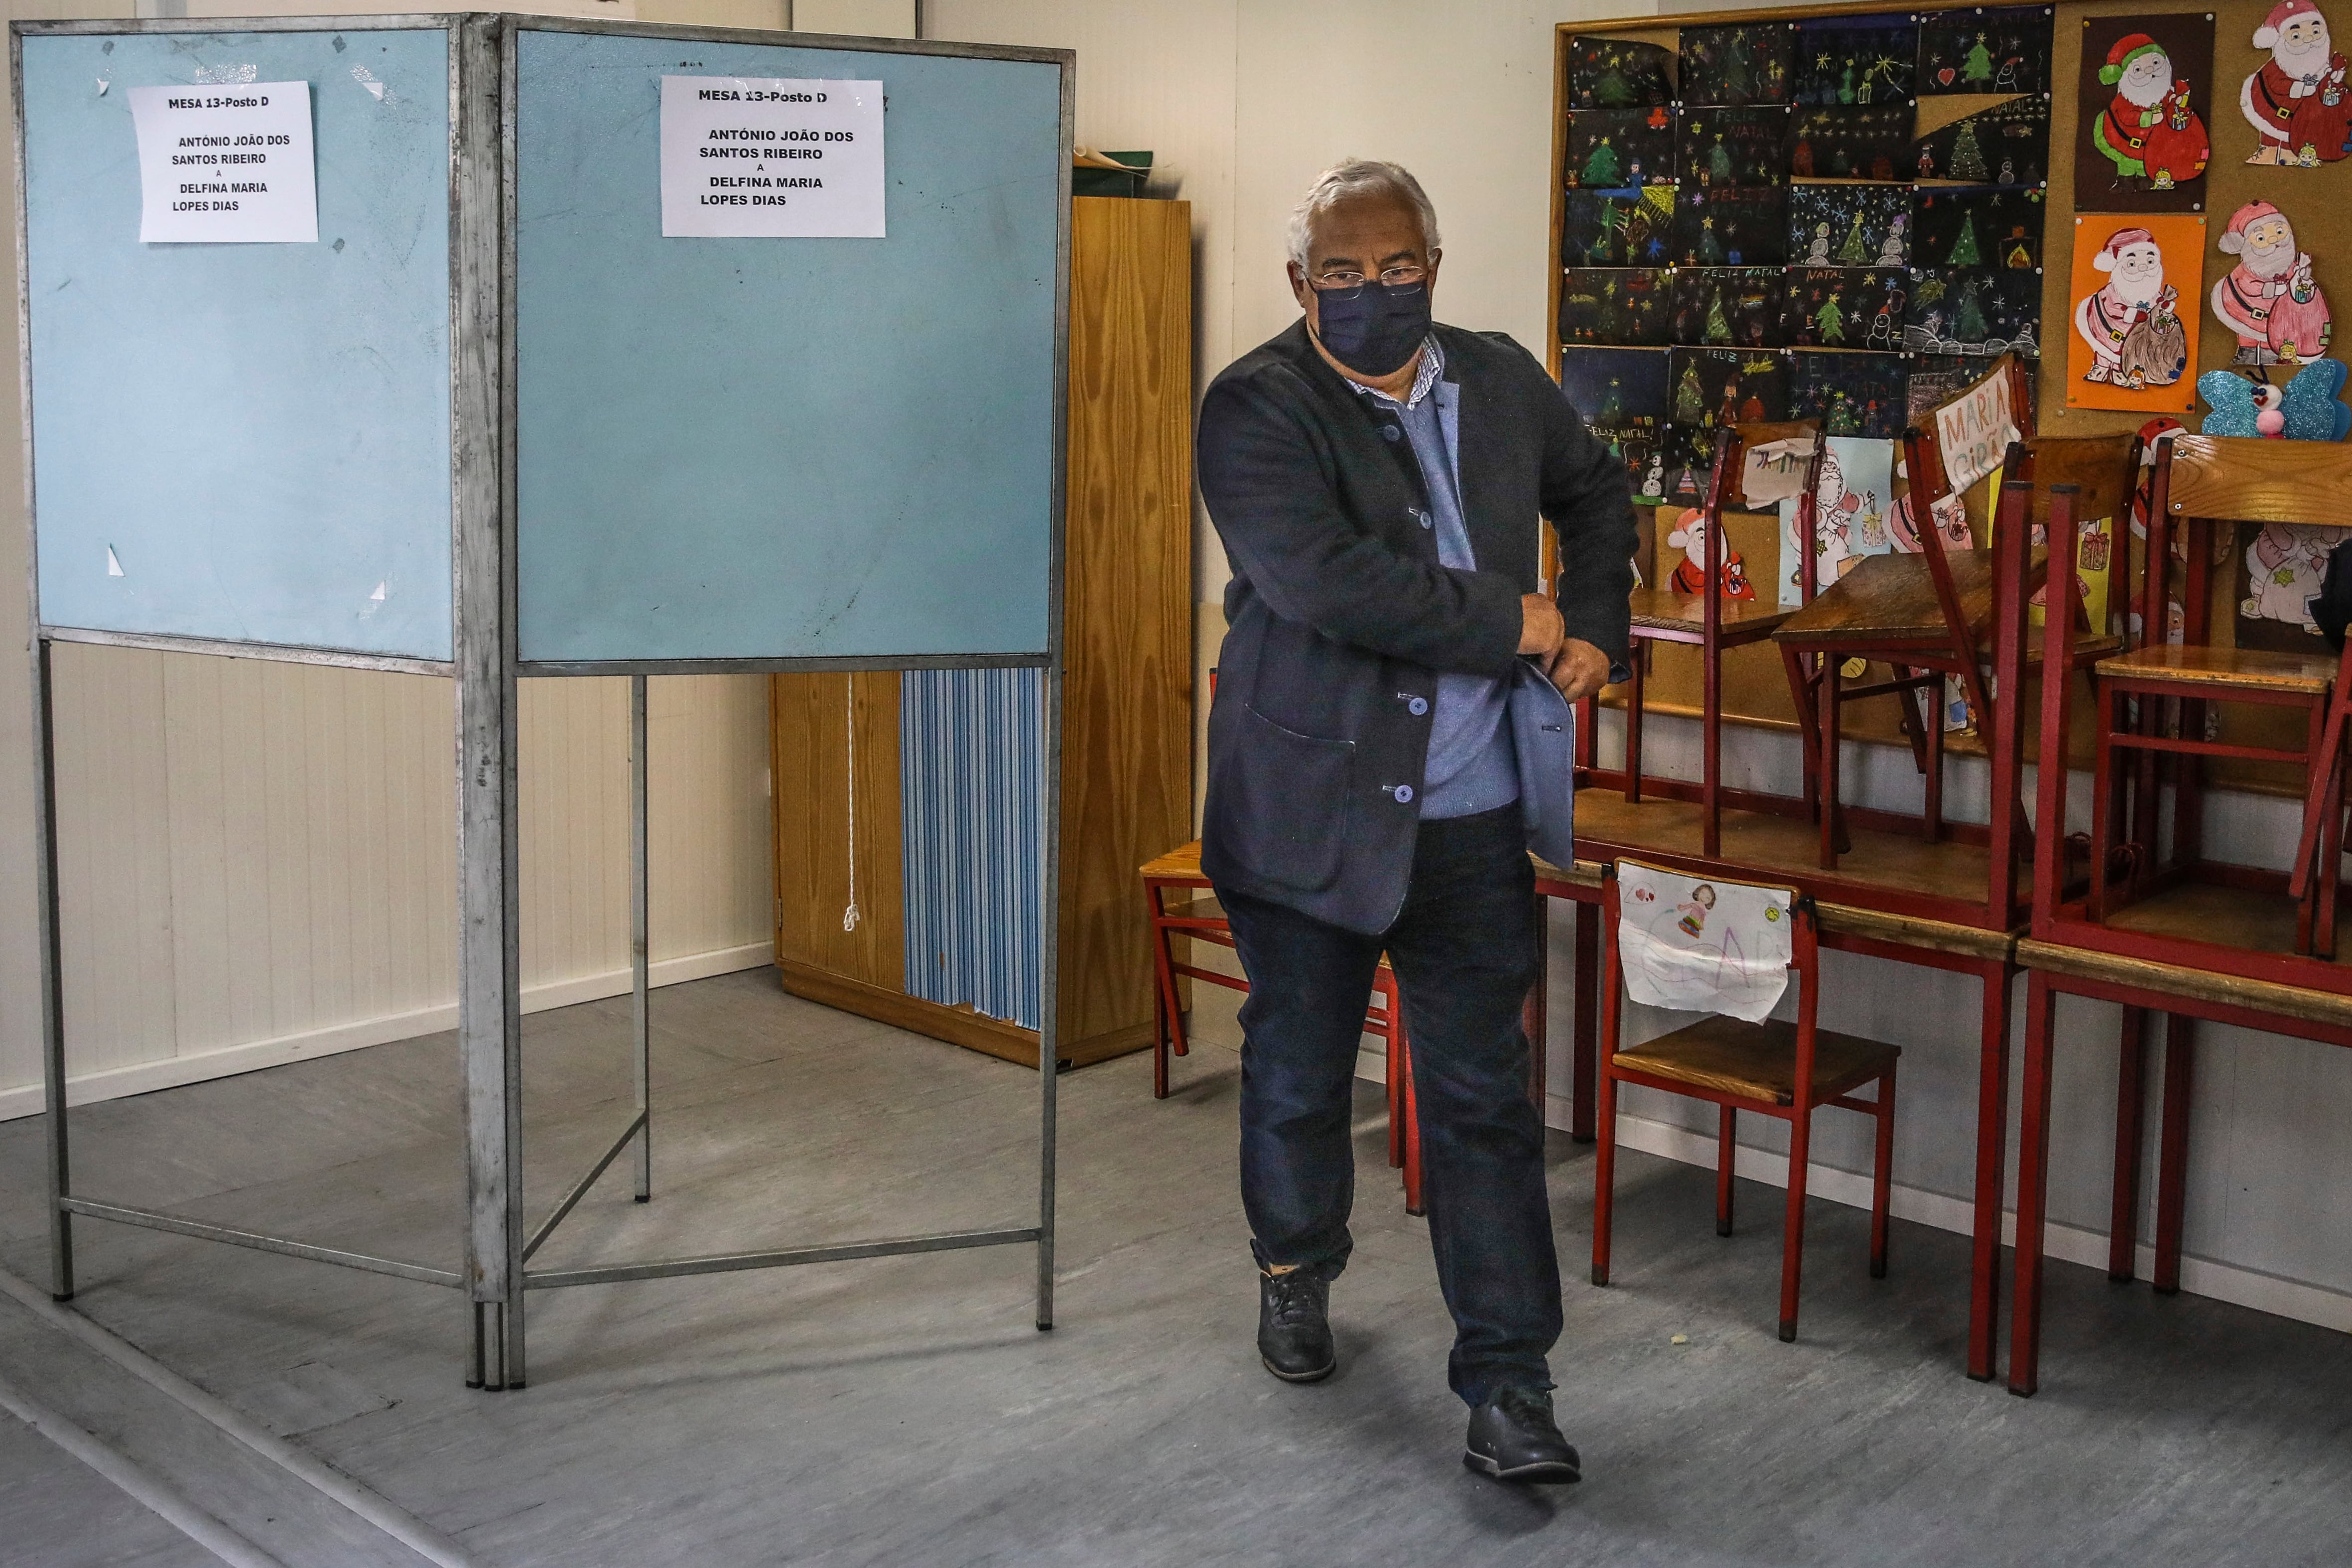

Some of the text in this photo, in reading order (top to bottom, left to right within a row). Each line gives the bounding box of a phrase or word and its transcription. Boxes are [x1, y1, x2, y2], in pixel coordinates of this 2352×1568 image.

[168, 96, 269, 110] MESA 13-Posto D
[698, 89, 828, 104] MESA 13-Posto D
[178, 133, 290, 148] ANTÓNIO JOÃO DOS
[708, 127, 854, 142] ANTÓNIO JOÃO DOS
[171, 153, 266, 166] SANTOS RIBEIRO
[699, 146, 823, 160] SANTOS RIBEIRO
[756, 163, 765, 172] A
[180, 182, 268, 194] DELFINA MARIA
[709, 176, 824, 189] DELFINA MARIA
[172, 200, 240, 212] LOPES DIAS
[700, 194, 787, 206] LOPES DIAS
[1702, 268, 1781, 278] FELIZ NATAL
[1806, 269, 1845, 283] NATAL
[1619, 428, 1654, 440] NATAL!
